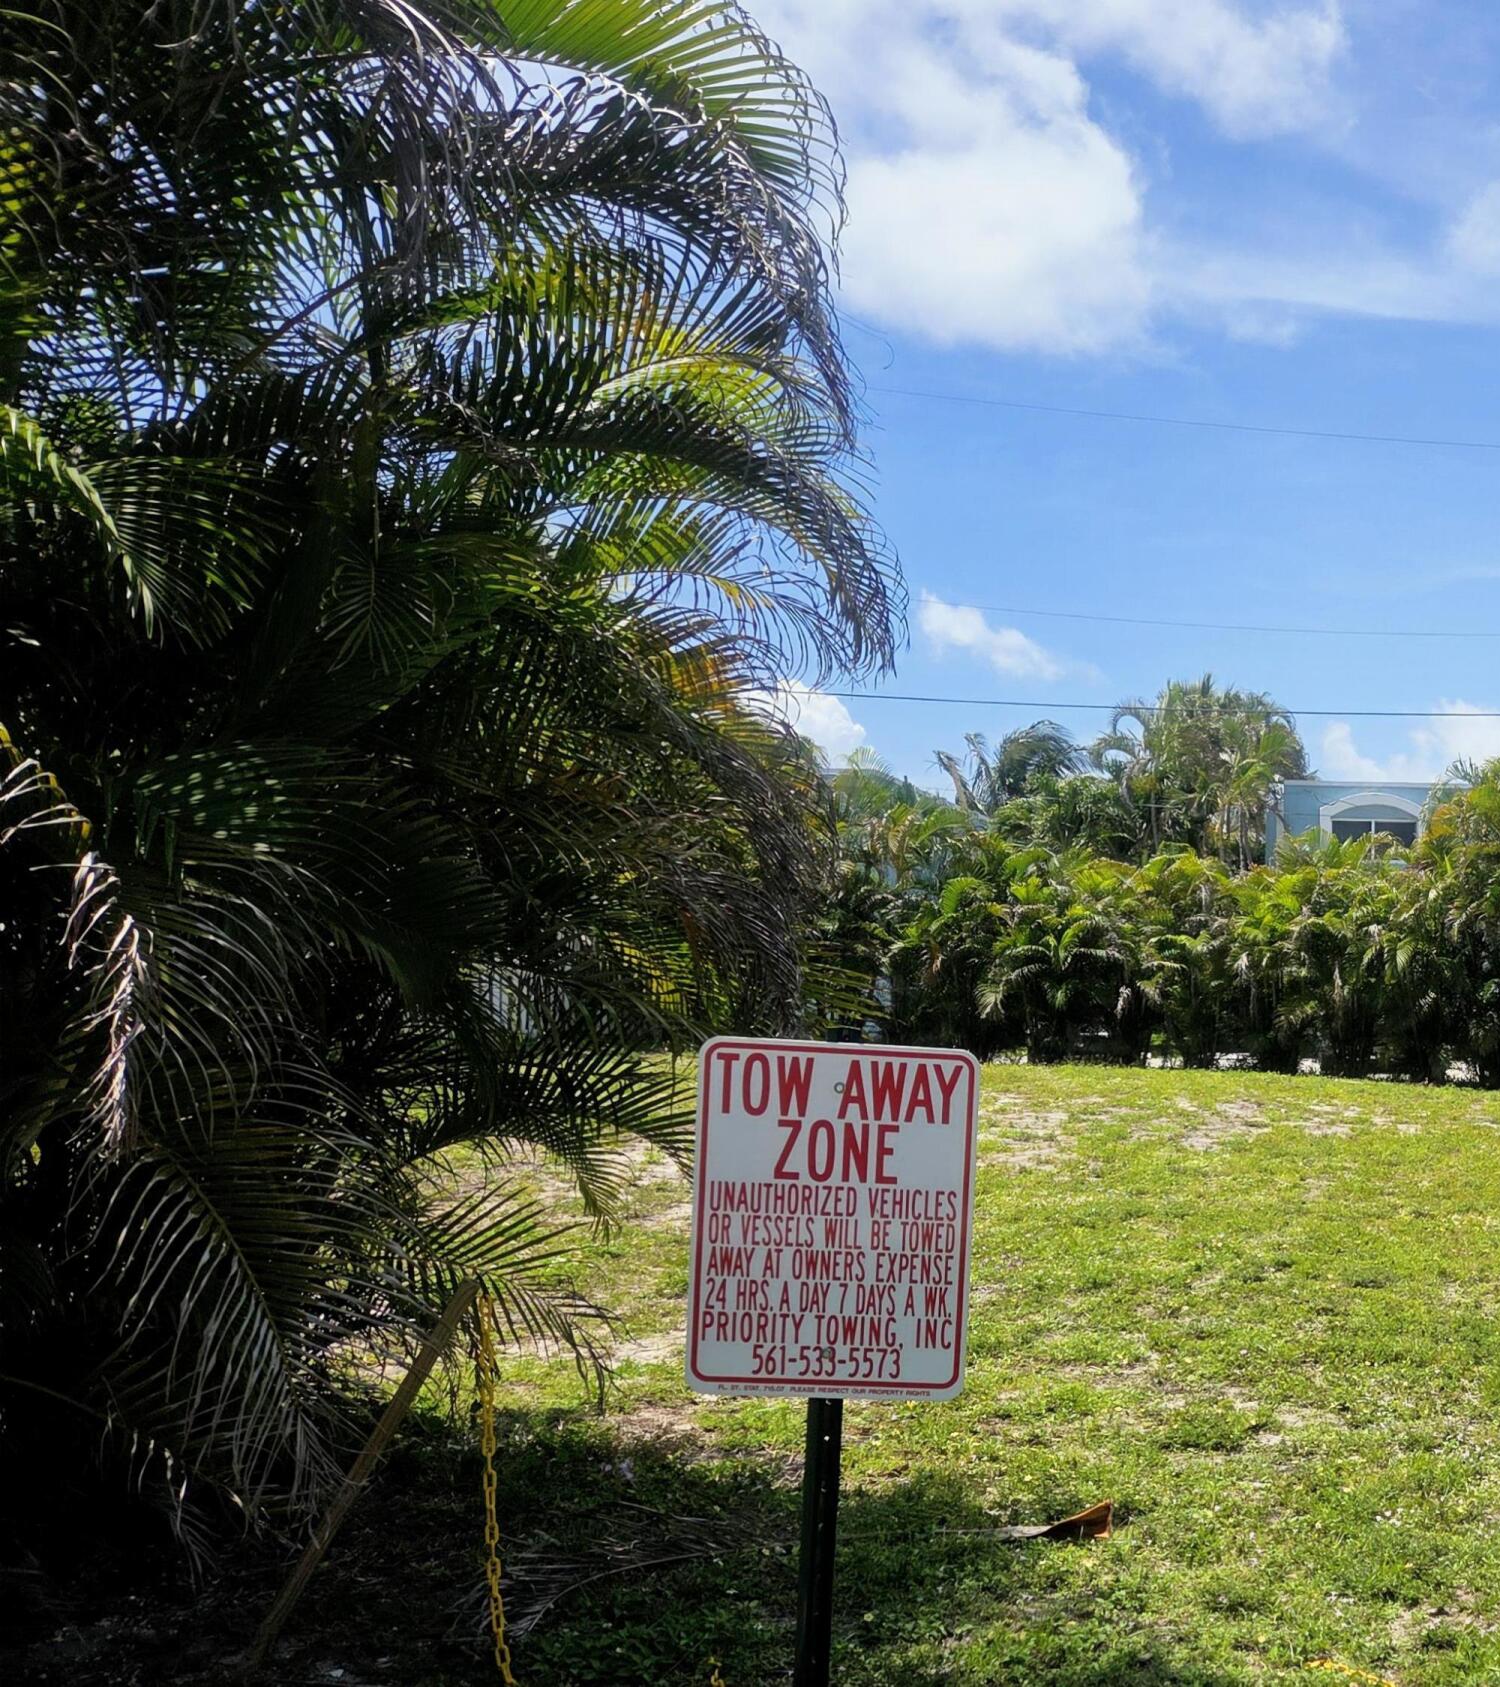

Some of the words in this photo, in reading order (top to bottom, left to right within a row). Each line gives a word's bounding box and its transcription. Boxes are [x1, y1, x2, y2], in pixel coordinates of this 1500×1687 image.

[717, 1052, 814, 1117] TOW
[837, 1059, 964, 1125] AWAY
[773, 1119, 900, 1185] ZONE
[710, 1181, 857, 1217] UNAUTHORIZED
[868, 1187, 957, 1222] VEHICLES
[708, 1213, 731, 1245] OR
[741, 1215, 814, 1248] VESSELS
[824, 1218, 862, 1250] WILL
[870, 1220, 891, 1251] BE
[900, 1221, 955, 1253] TOWED
[706, 1246, 754, 1278] AWAY
[762, 1248, 784, 1279] AT
[792, 1250, 865, 1282] OWNERS
[875, 1252, 954, 1285] EXPENSE
[704, 1278, 726, 1310] 24
[736, 1279, 773, 1312] HRS.
[779, 1281, 790, 1312] A
[801, 1282, 831, 1314] DAY
[839, 1283, 848, 1314] 7
[857, 1284, 896, 1316] DAYS
[904, 1286, 915, 1317] A
[924, 1287, 952, 1318] WK.
[701, 1311, 804, 1344] PRIORITY
[815, 1315, 904, 1350] TOWING,
[915, 1318, 952, 1350] INC
[752, 1345, 901, 1379] 561-533-5573
[868, 1388, 904, 1396] PROPERTY
